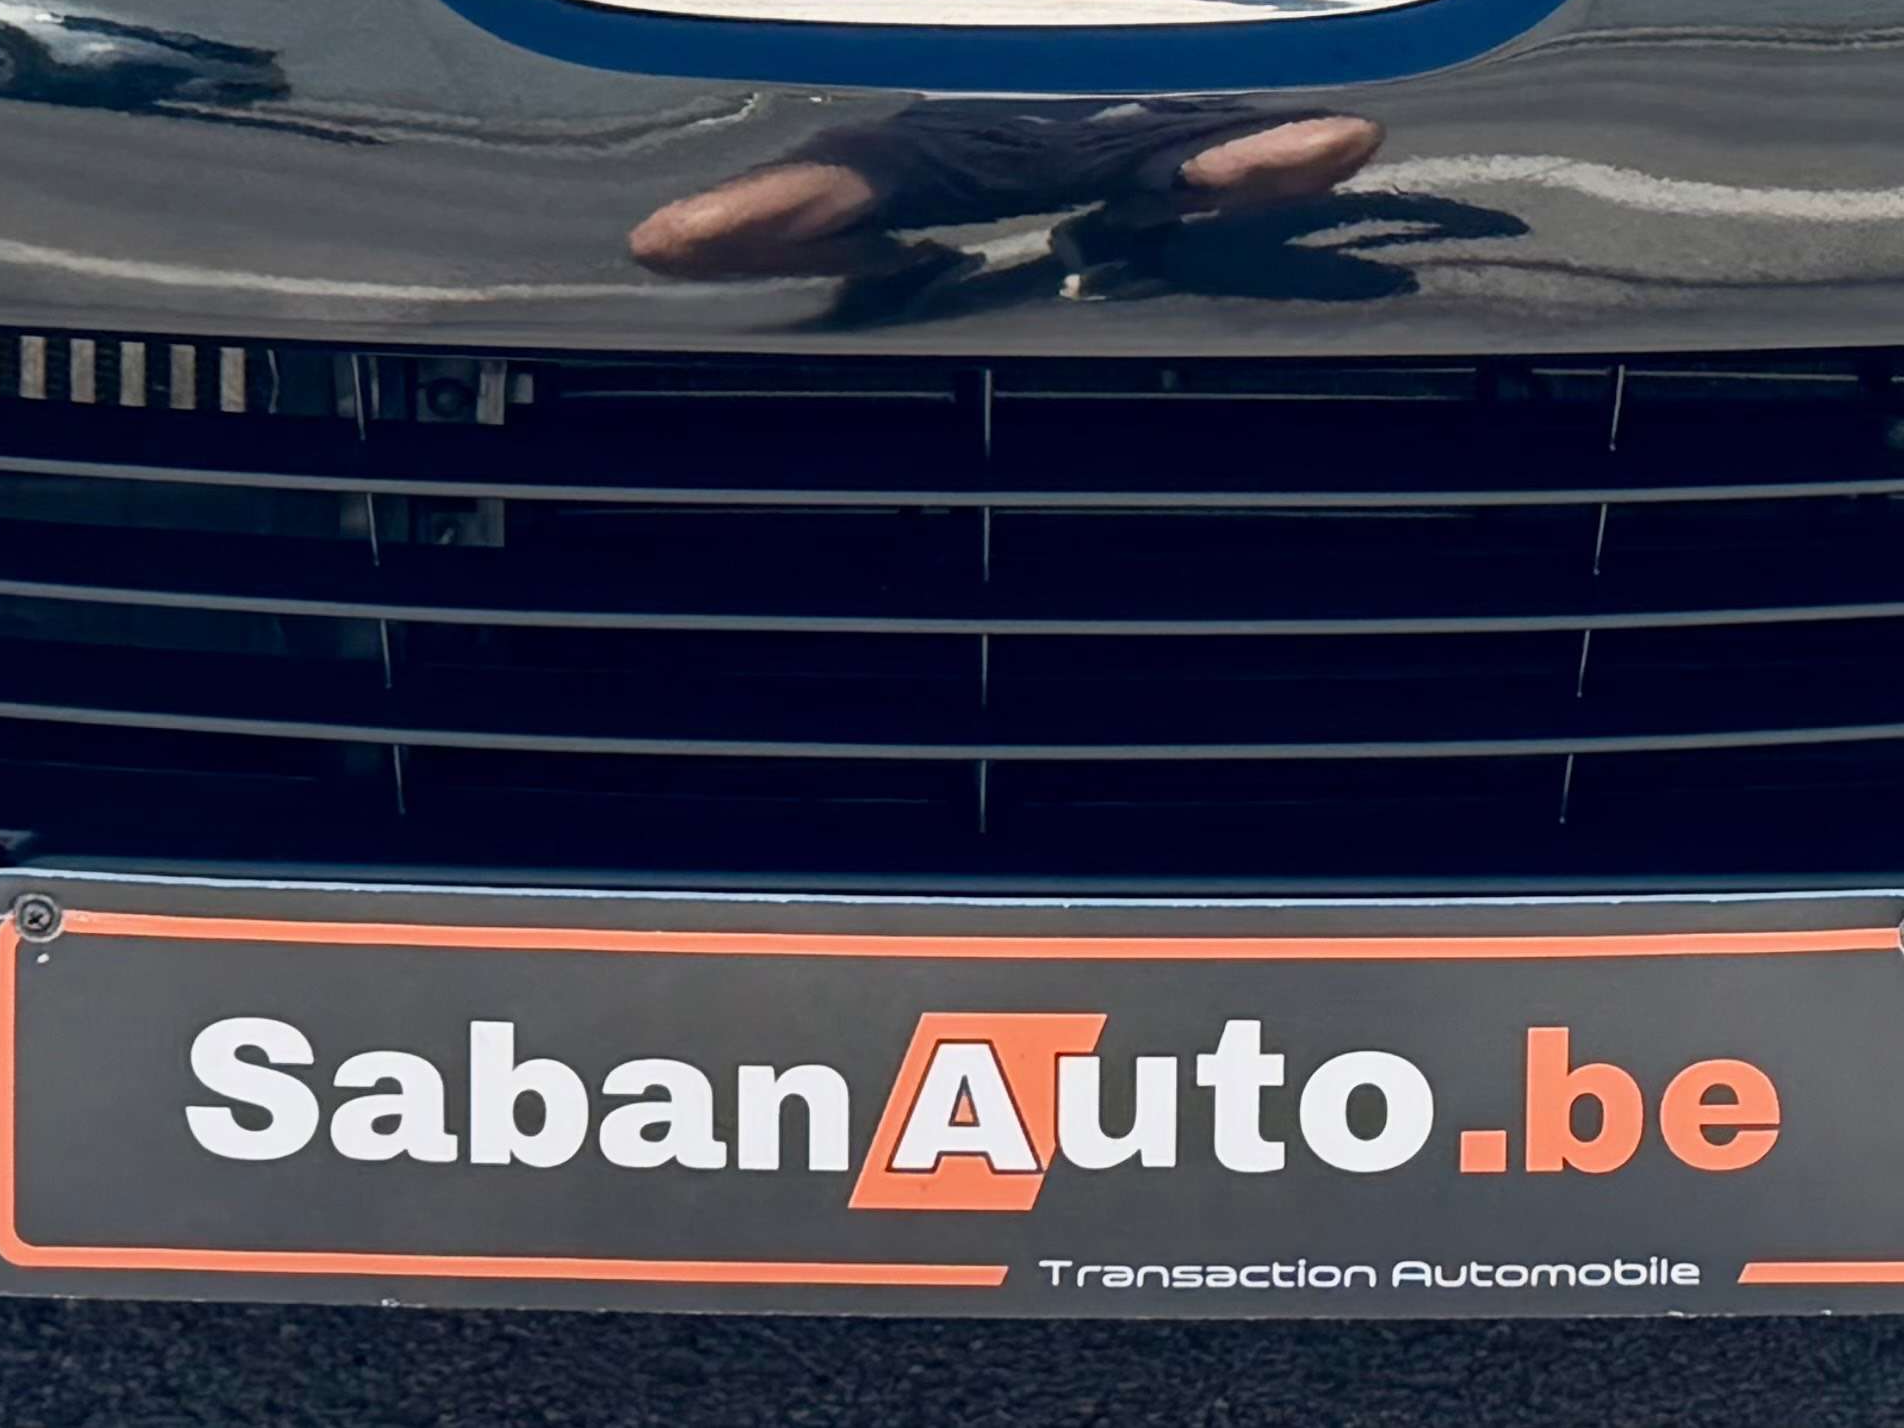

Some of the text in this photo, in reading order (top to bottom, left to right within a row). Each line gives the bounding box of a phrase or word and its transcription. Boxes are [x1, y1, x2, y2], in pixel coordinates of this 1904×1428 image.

[185, 1014, 1781, 1174] SabanAuto.be
[1038, 1259, 1701, 1289] Transaction Automobile
